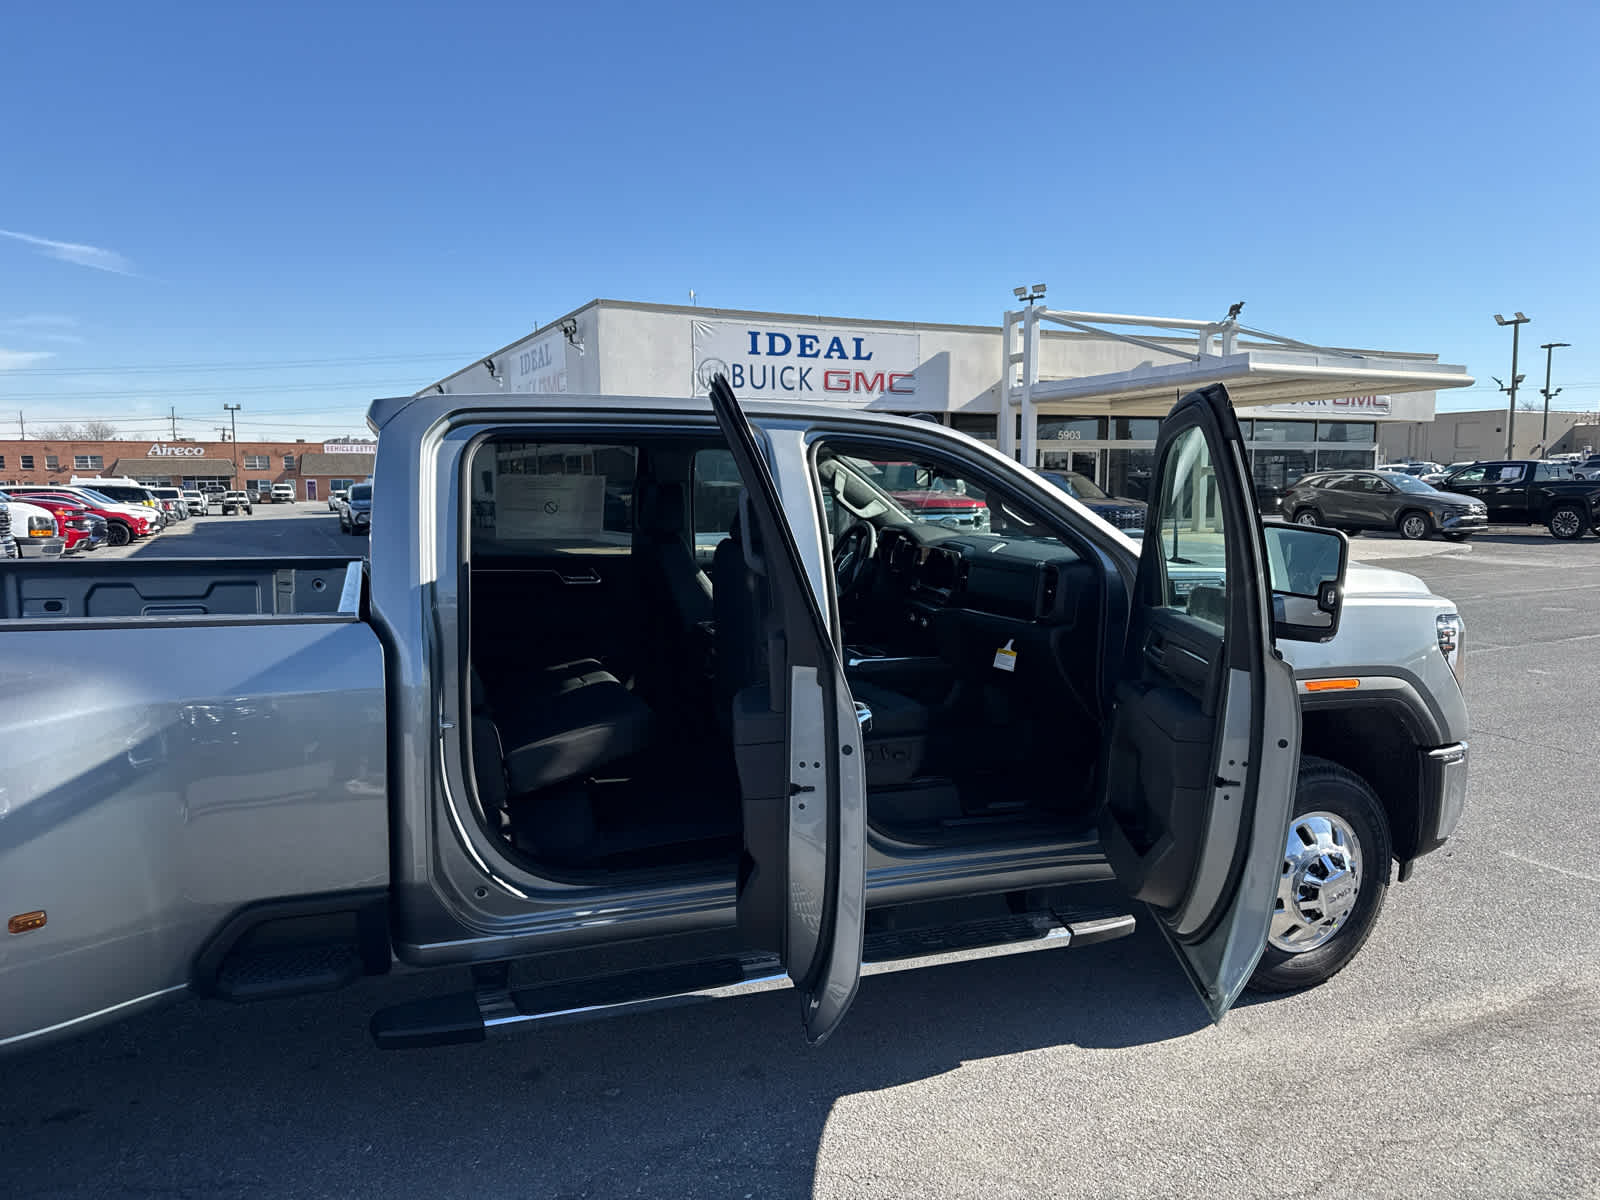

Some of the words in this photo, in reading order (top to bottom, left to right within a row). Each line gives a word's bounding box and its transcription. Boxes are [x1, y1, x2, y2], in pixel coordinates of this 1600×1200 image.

[519, 343, 552, 376] IDEAL
[748, 331, 873, 361] IDEAL
[732, 363, 814, 392] BUICK
[823, 370, 915, 394] GMC
[147, 443, 205, 456] Aireco
[1057, 430, 1081, 440] 5903
